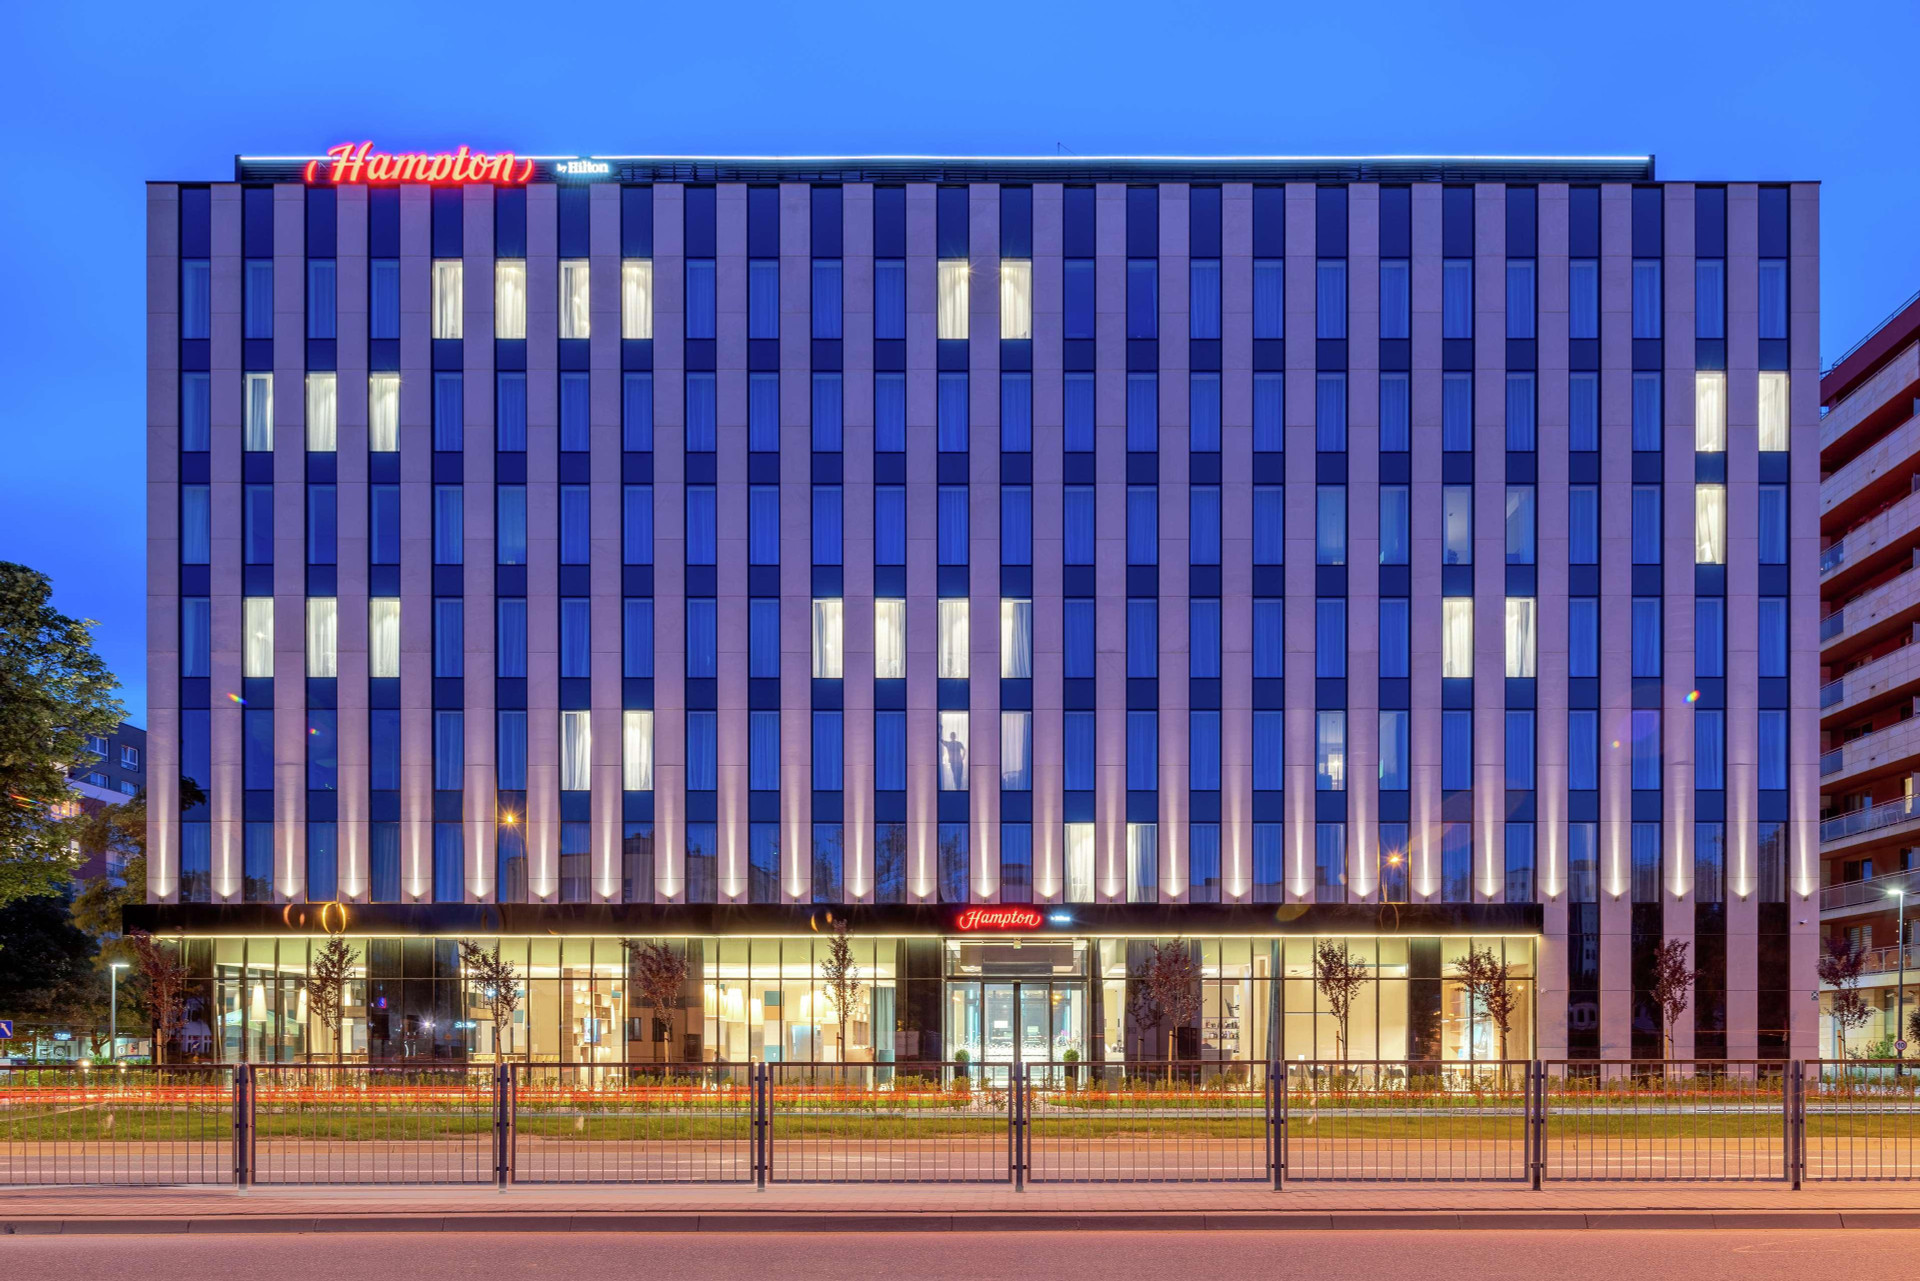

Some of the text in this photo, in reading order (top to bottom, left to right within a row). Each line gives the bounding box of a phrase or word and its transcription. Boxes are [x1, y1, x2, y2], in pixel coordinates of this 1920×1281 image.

[306, 141, 533, 182] Hampton
[568, 160, 609, 173] Hilton
[959, 911, 1040, 929] Hampton
